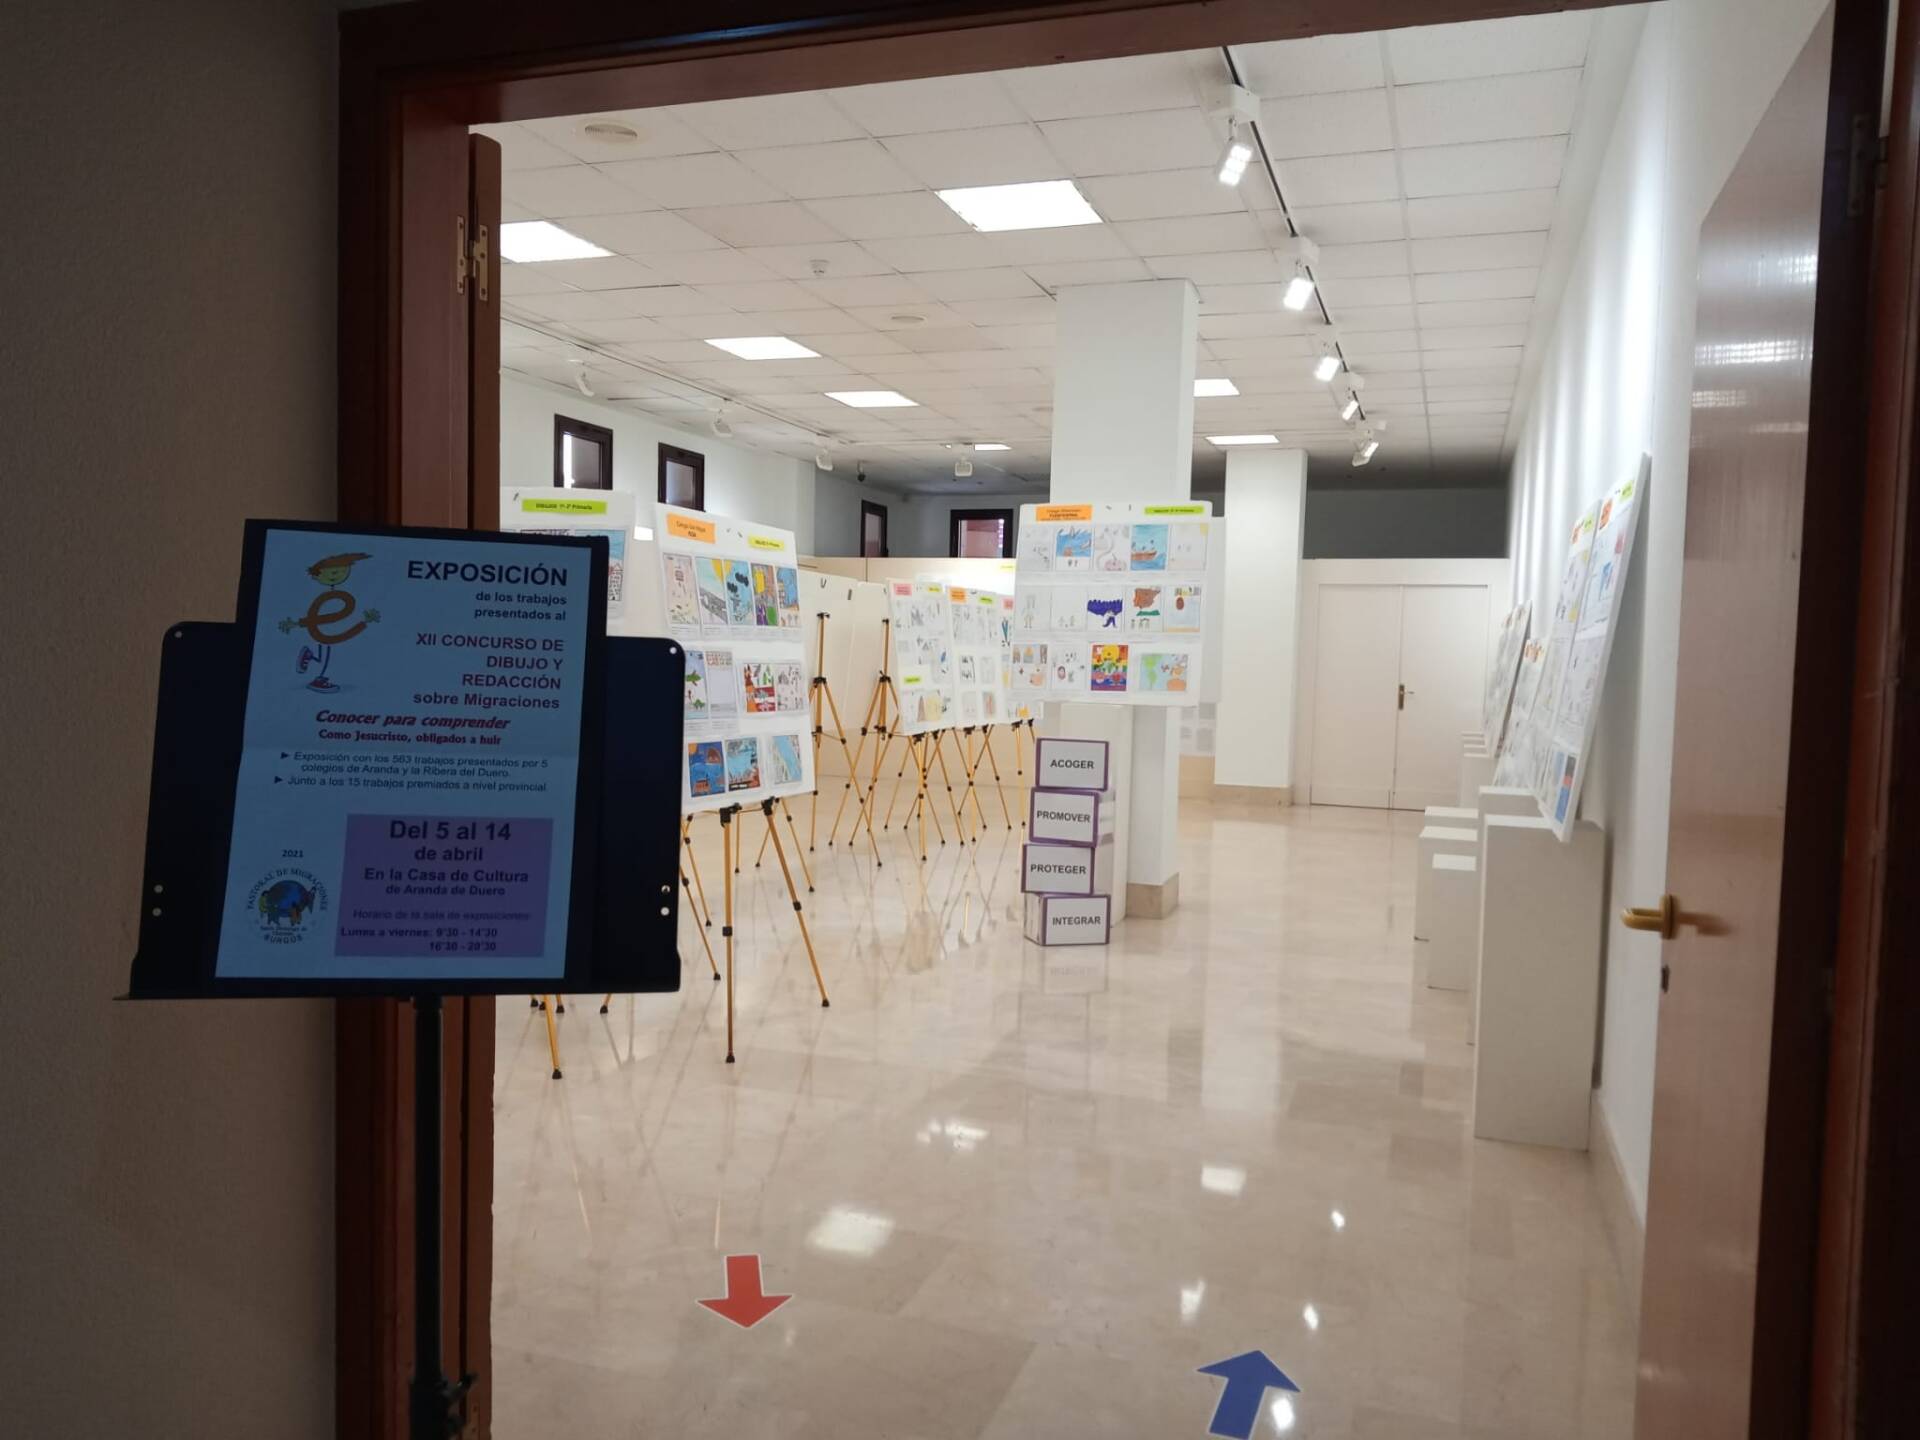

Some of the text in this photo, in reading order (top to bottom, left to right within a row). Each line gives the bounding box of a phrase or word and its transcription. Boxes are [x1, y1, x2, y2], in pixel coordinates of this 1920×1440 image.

[407, 560, 568, 586] EXPOSICIÓN
[476, 591, 567, 607] de los trabajos
[474, 607, 566, 621] presentados al
[416, 633, 563, 651] XII CONCURSO DE
[486, 655, 563, 670] DIBUJO Y
[462, 673, 561, 690] REDACCIÓN
[413, 692, 560, 710] sobre Migraciones
[315, 710, 511, 731] Conocer para comprender
[319, 729, 352, 740] Como
[355, 729, 412, 743] Jesucristo,
[415, 733, 466, 744] obligados
[470, 736, 477, 744] a
[294, 751, 351, 763] Exposición
[353, 755, 372, 763] con
[374, 754, 389, 763] los
[414, 756, 455, 766] trabajos
[457, 757, 520, 768] presentados
[522, 759, 538, 768] por
[1050, 759, 1094, 769] ACOGER
[301, 763, 346, 774] colegios
[347, 764, 361, 772] de
[363, 765, 400, 774] Aranda
[402, 767, 409, 776] y
[411, 766, 421, 775] la
[423, 766, 457, 776] Ribera
[460, 767, 475, 777] del
[288, 776, 317, 785] Junto
[329, 776, 345, 786] los
[348, 777, 361, 786] 15
[363, 778, 405, 789] trabajos
[406, 780, 461, 790] premiados
[472, 781, 496, 790] nivel
[1037, 810, 1091, 823] PROMOVER
[390, 820, 511, 841] Del 5 al 14
[282, 849, 304, 857] 2021
[414, 846, 482, 861] de abril
[364, 868, 529, 883] En la Casa de Cultura
[1030, 863, 1086, 875] PROTEGER
[386, 885, 506, 896] de Aranda de Duero
[353, 910, 393, 919] Horario
[395, 911, 408, 920] de
[1052, 916, 1101, 925] INTEGRAR
[341, 927, 375, 937] Lunes
